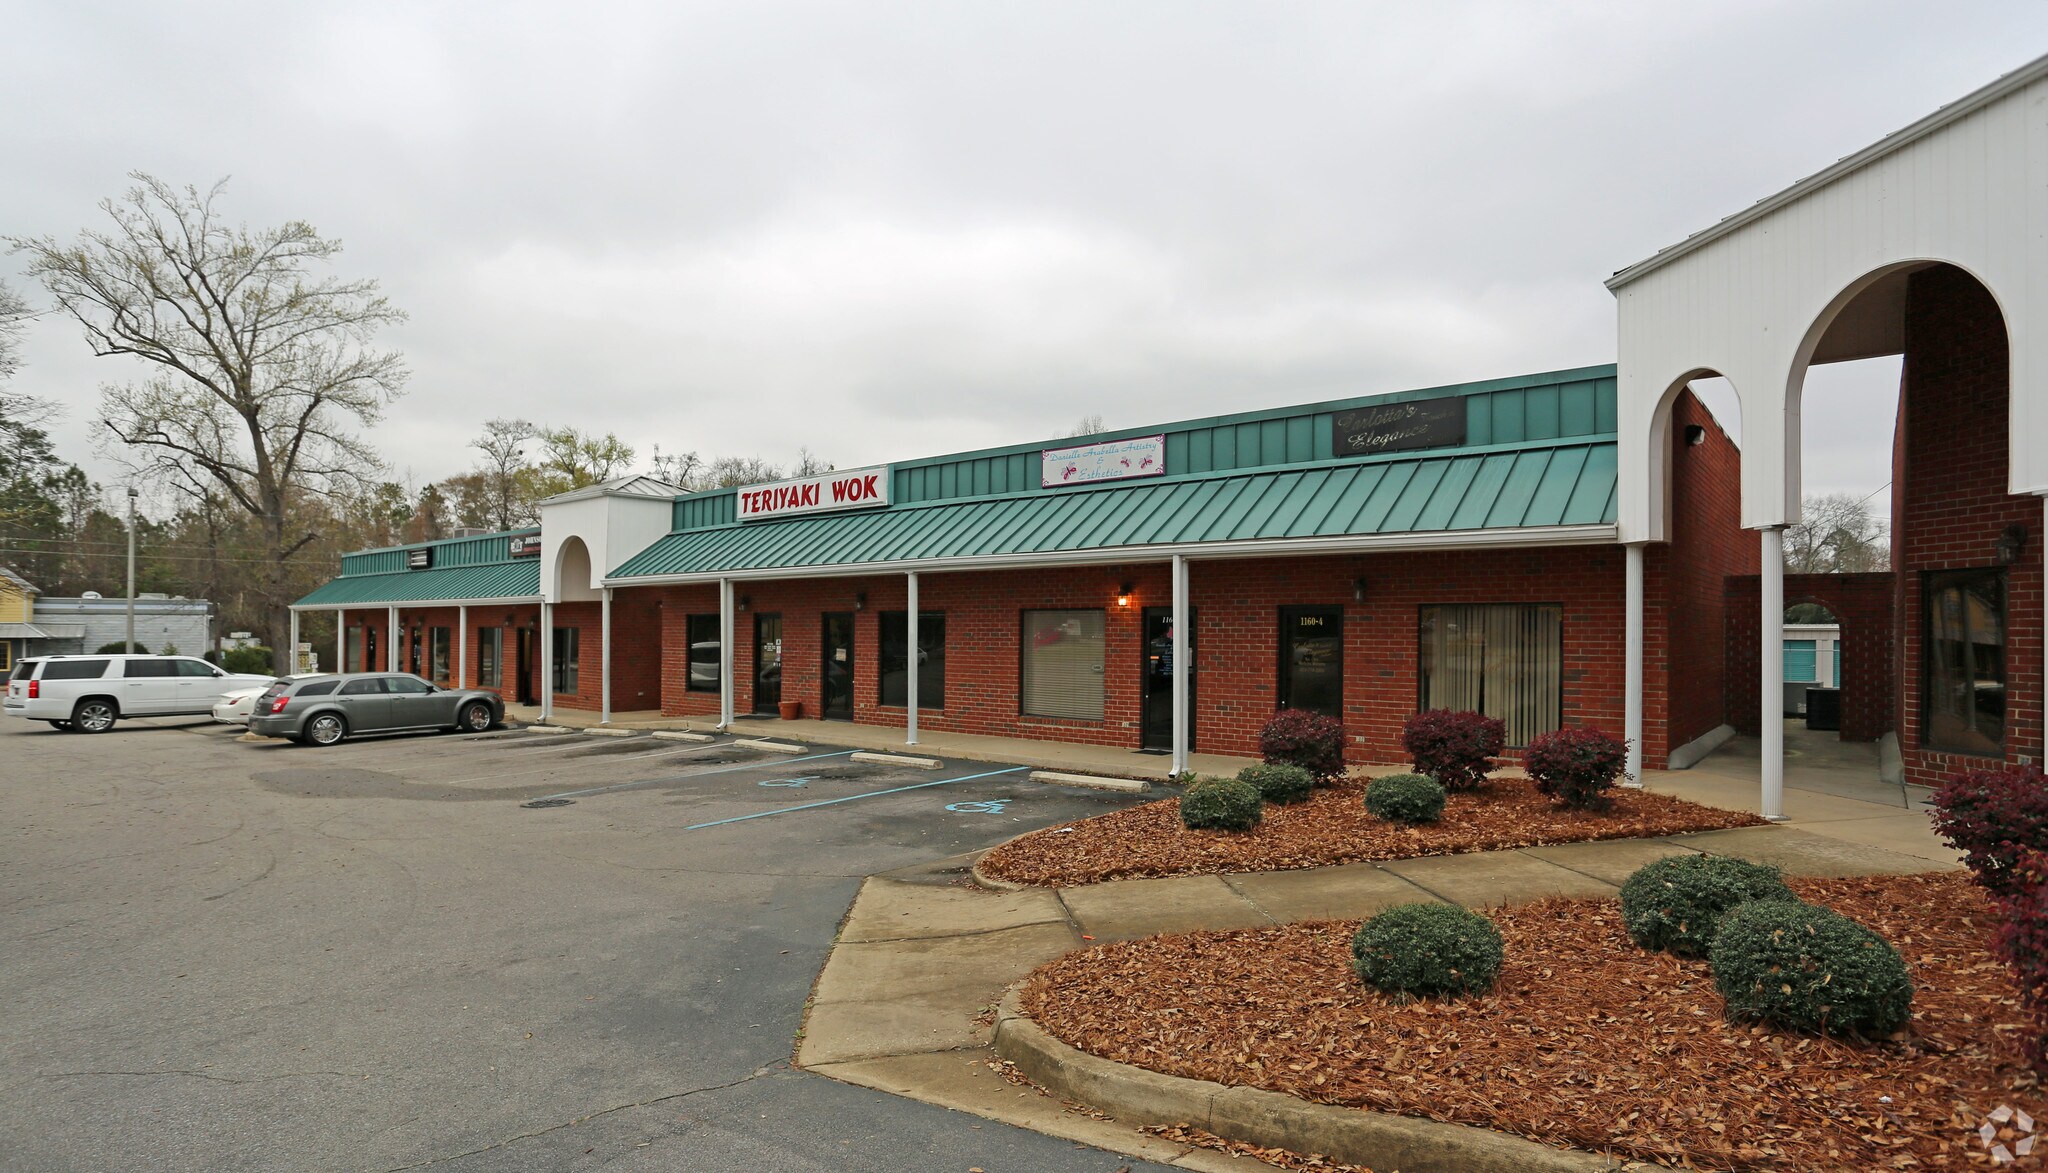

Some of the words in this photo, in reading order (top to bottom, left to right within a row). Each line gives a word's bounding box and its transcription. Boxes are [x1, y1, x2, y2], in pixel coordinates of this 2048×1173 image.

[1348, 424, 1430, 449] Elegance
[1050, 449, 1080, 461] Danielle
[1082, 445, 1119, 457] Arabella
[1121, 442, 1157, 452] Artistry
[1078, 467, 1123, 480] Esthetics
[741, 483, 820, 513] TERIYAKI
[832, 475, 878, 503] WOK
[1162, 616, 1173, 624] 116
[1300, 617, 1323, 626] 1160-4
